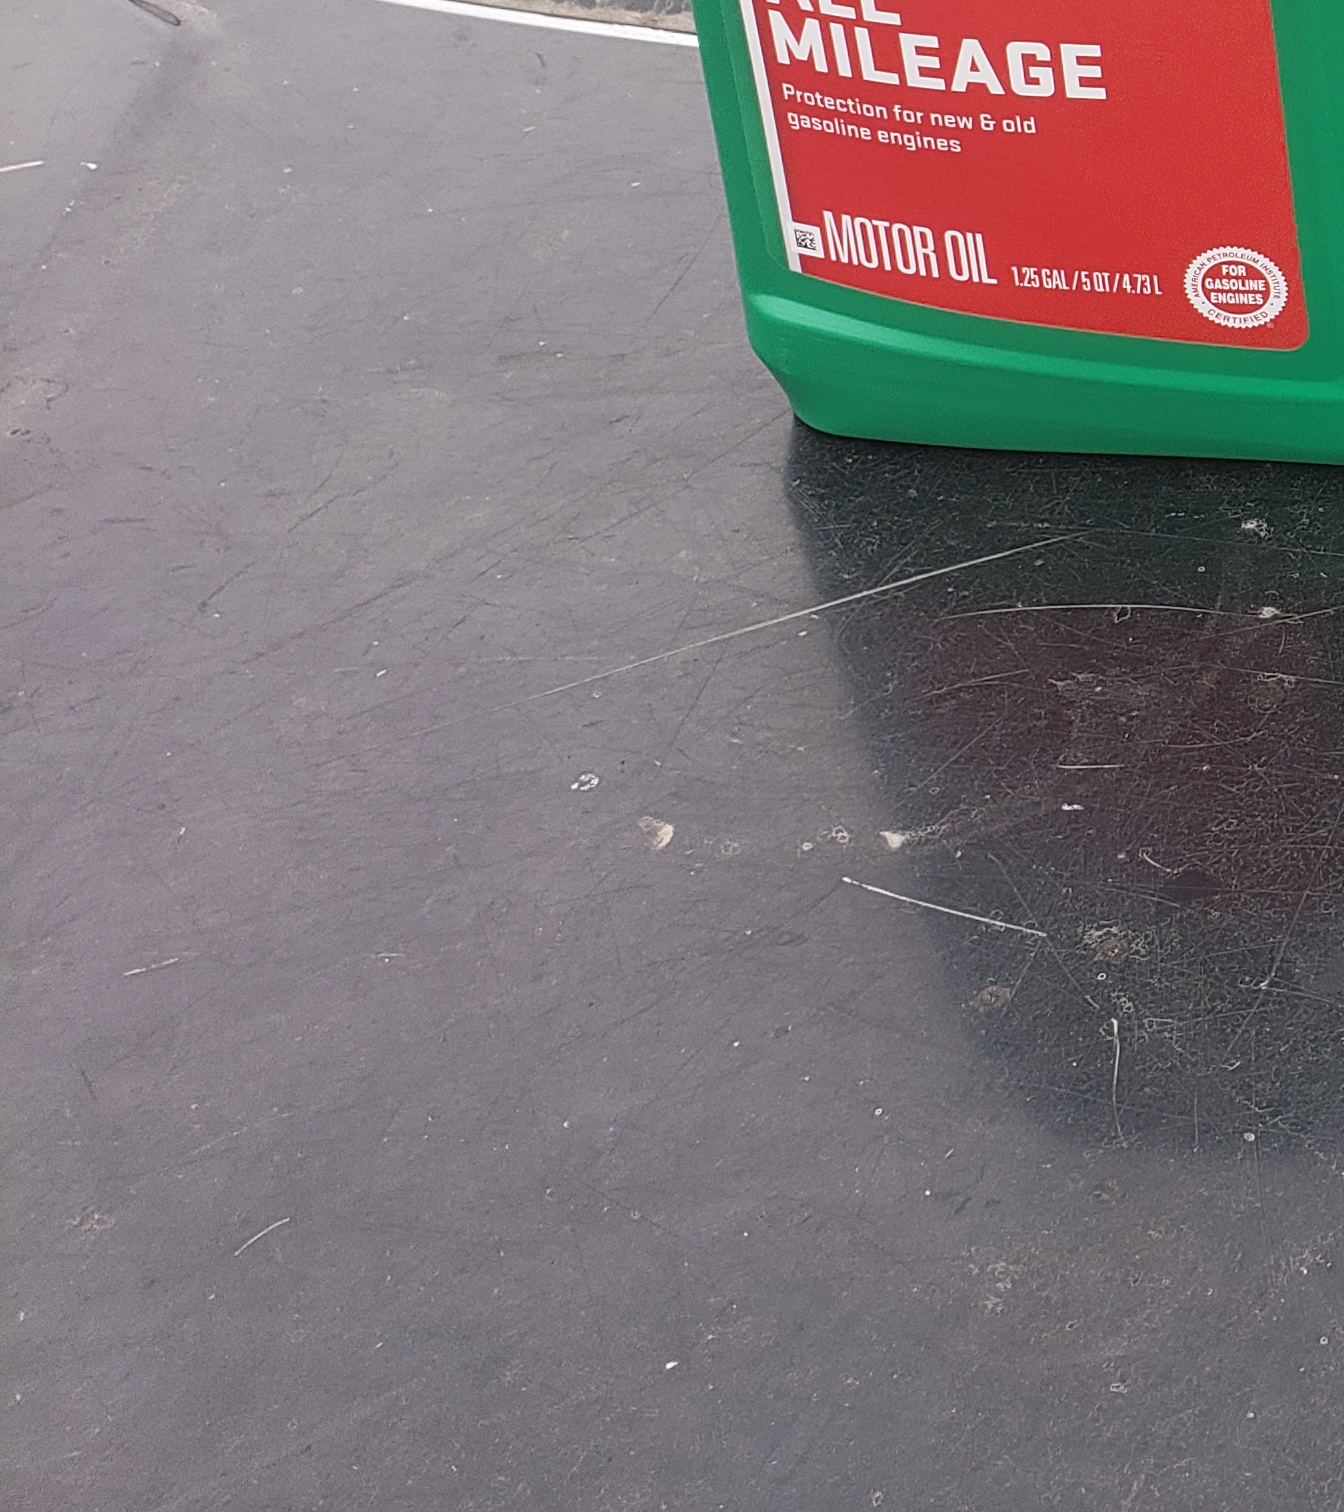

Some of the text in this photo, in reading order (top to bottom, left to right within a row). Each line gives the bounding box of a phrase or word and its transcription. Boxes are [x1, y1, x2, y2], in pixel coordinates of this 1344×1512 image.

[768, 9, 1107, 100] MILEAGE
[782, 82, 1037, 134] Protection for new & old
[786, 110, 962, 153] gasoline engines
[822, 210, 998, 284] MOTOR OIL
[1011, 266, 1039, 288] 1.25
[1041, 268, 1070, 290] GAL
[1081, 271, 1090, 292] 5
[1093, 272, 1110, 293] QT
[1122, 273, 1151, 294] 4.73
[1154, 275, 1163, 295] L
[1205, 278, 1266, 291] GASOLINE
[1207, 251, 1260, 265] PETROLEUM
[1260, 262, 1281, 300] INSTITUTE
[1221, 264, 1247, 276] FOR
[1207, 308, 1268, 324] CERTIFIED
[1210, 292, 1264, 305] ENGINES
